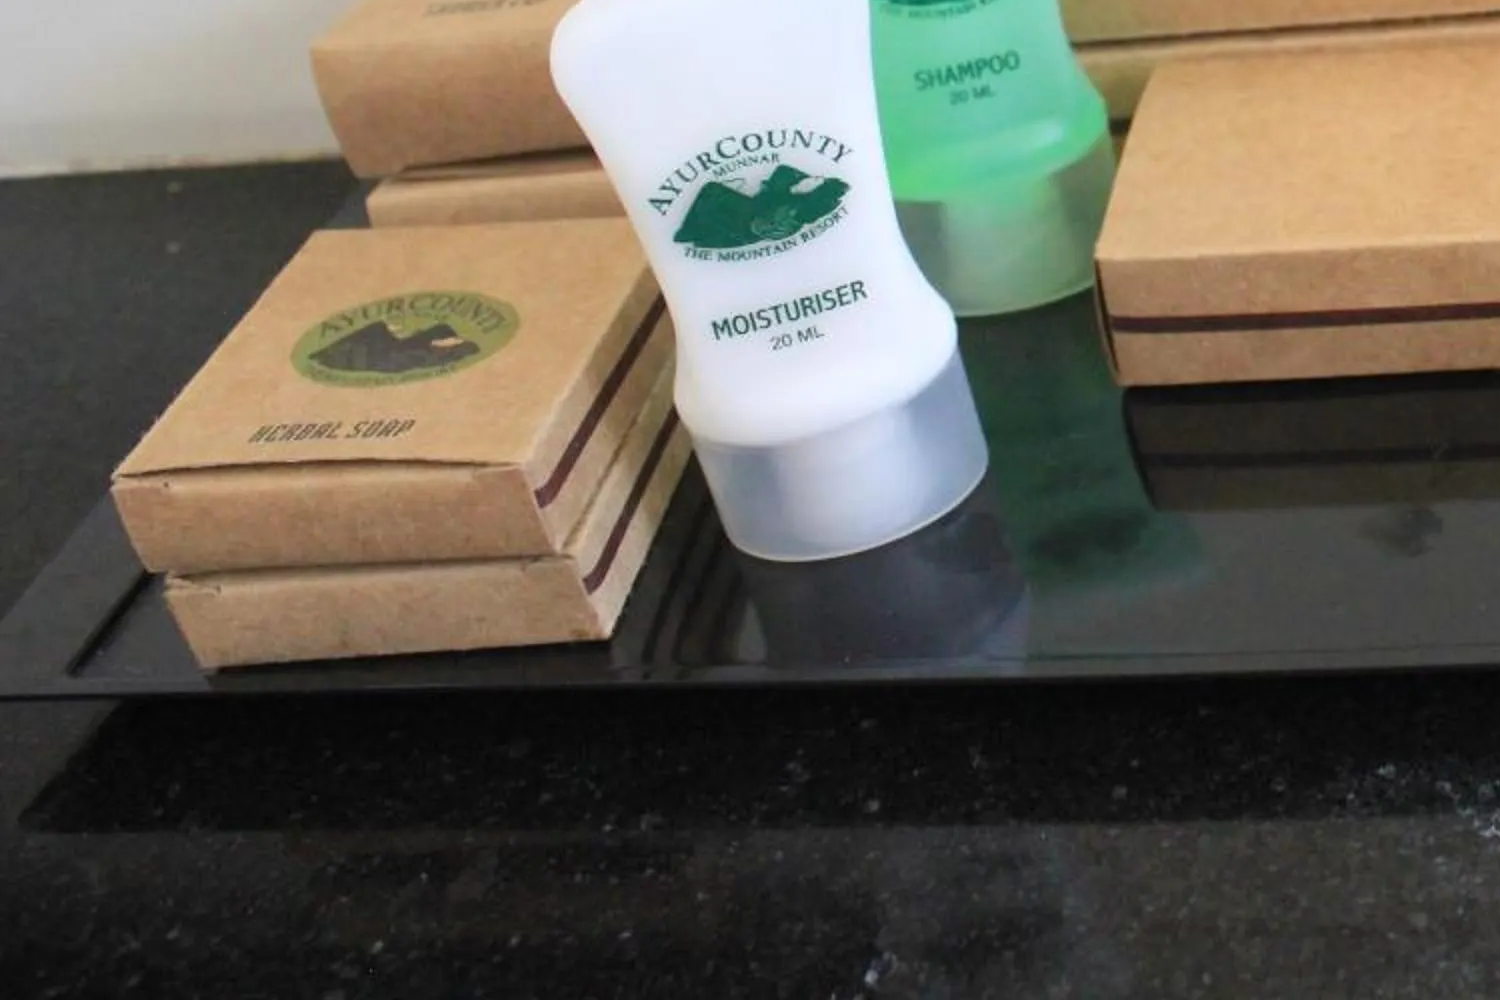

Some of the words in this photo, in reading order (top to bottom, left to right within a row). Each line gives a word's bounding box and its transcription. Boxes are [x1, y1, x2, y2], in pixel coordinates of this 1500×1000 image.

[913, 50, 1021, 91] SHAMPOO
[950, 87, 970, 105] 20
[972, 83, 996, 99] ML
[648, 129, 853, 215] AYURCOUNTY
[711, 151, 782, 179] MUNNAR
[684, 246, 714, 262] THE
[717, 238, 799, 263] MOUNTAIN
[800, 206, 850, 244] RESORT
[711, 280, 868, 340] MOISTURISER
[769, 333, 794, 352] 20
[796, 325, 826, 345] ML
[248, 421, 342, 443] HERBAL
[345, 418, 417, 439] SOAP
